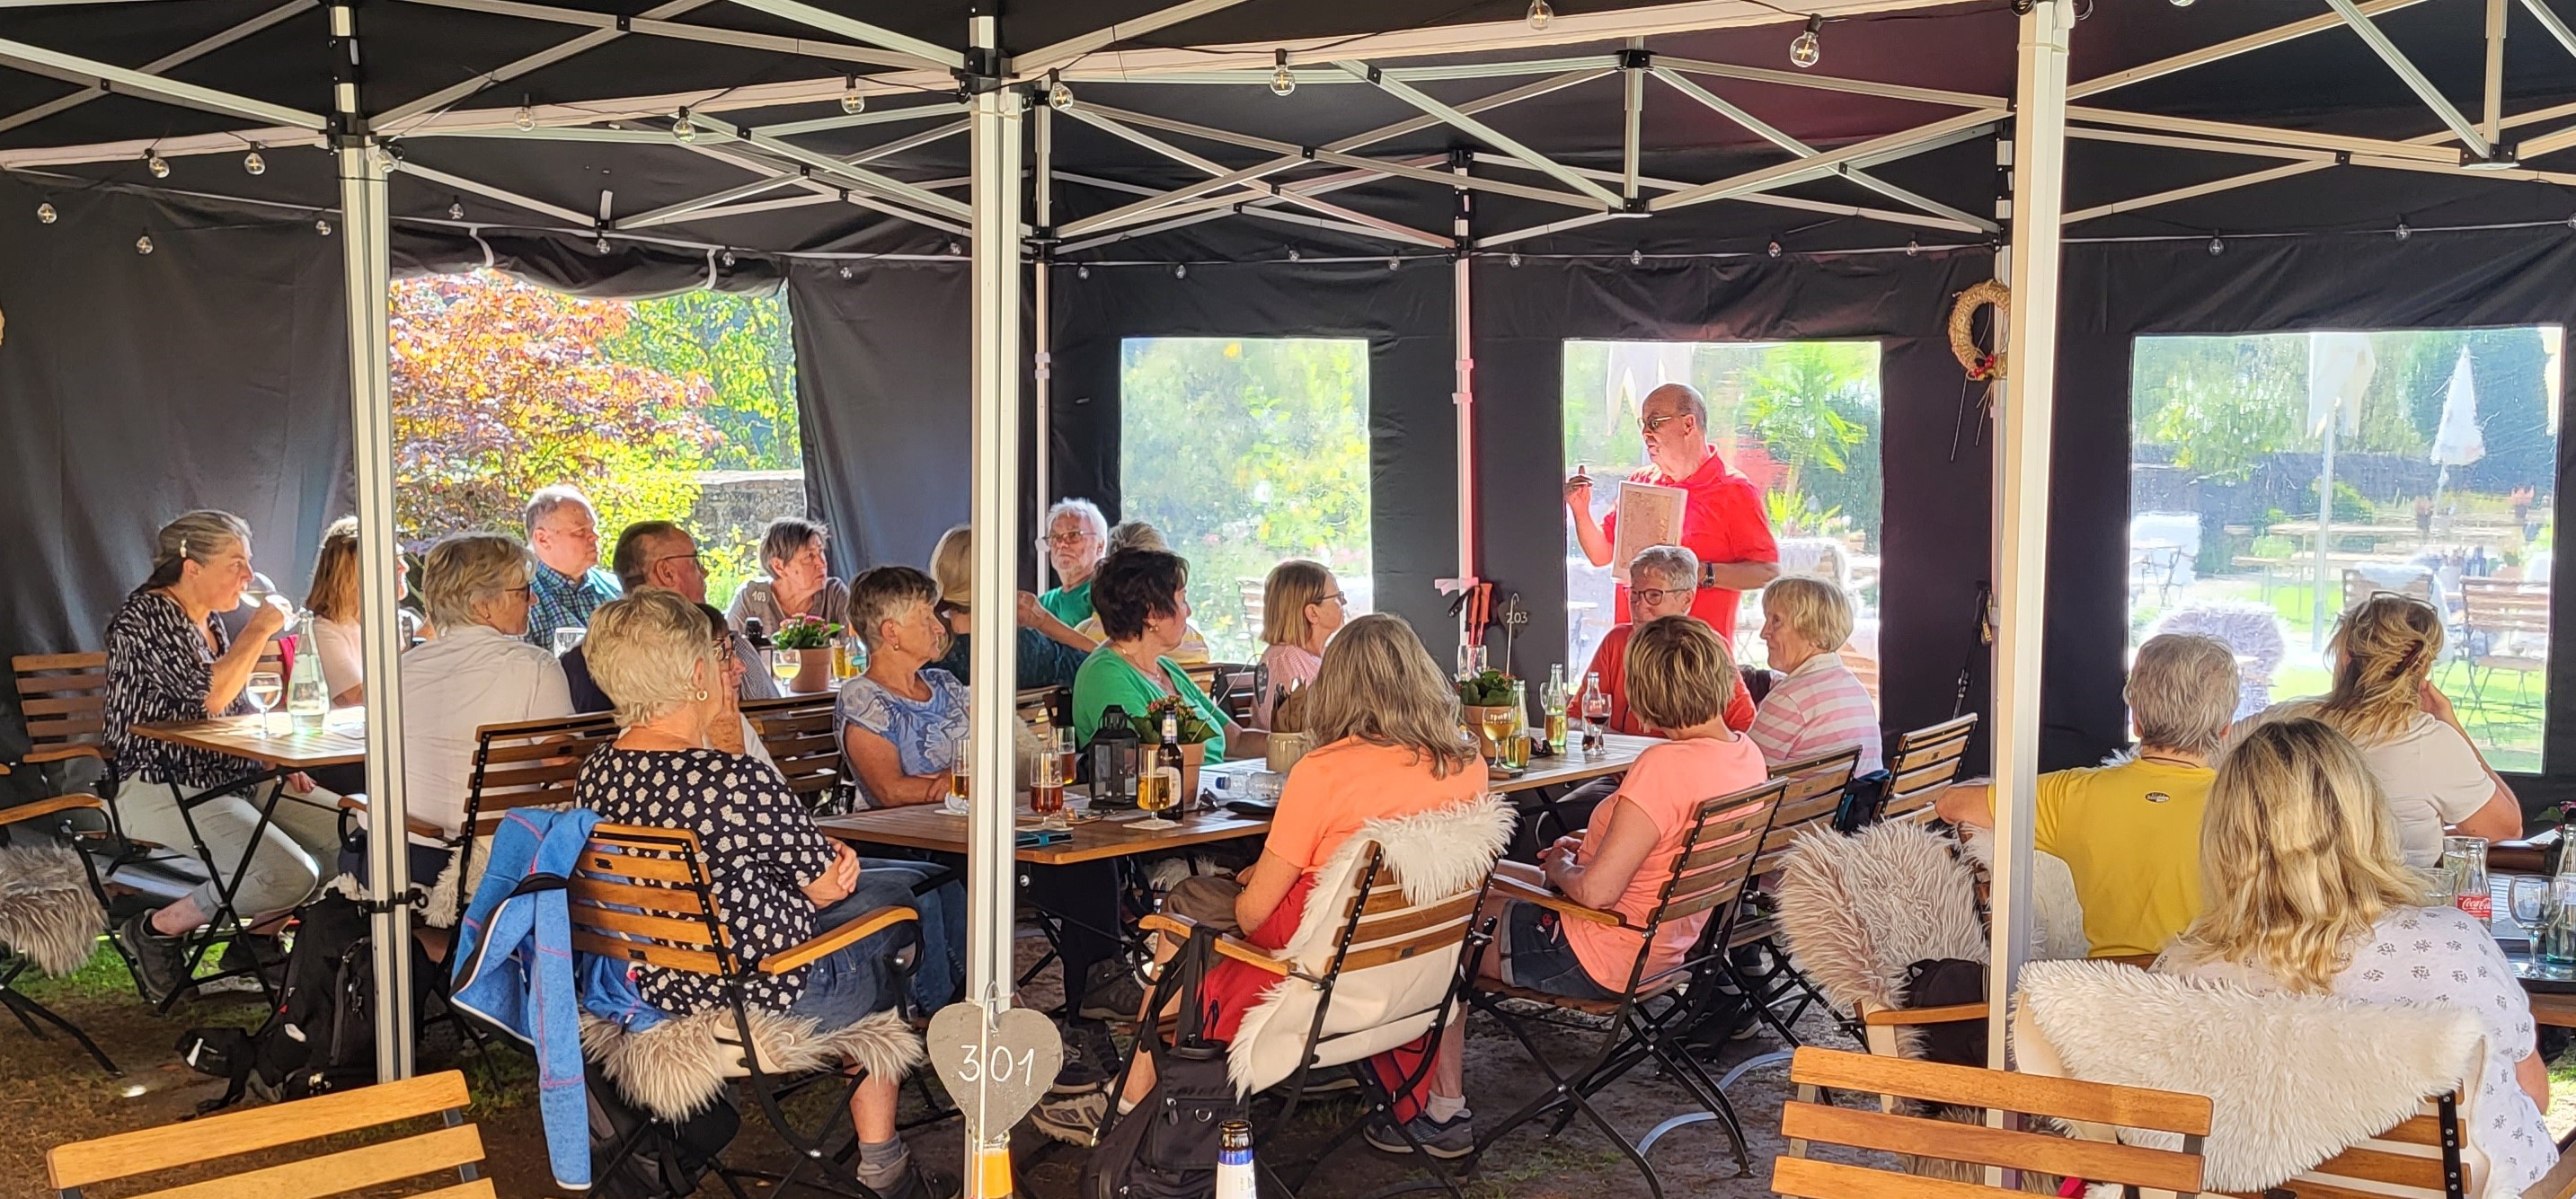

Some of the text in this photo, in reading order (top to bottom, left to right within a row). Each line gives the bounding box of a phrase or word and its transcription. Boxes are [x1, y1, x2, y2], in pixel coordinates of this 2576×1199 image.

[751, 590, 767, 602] 103
[1505, 611, 1528, 624] 203
[958, 1045, 1035, 1087] 301
